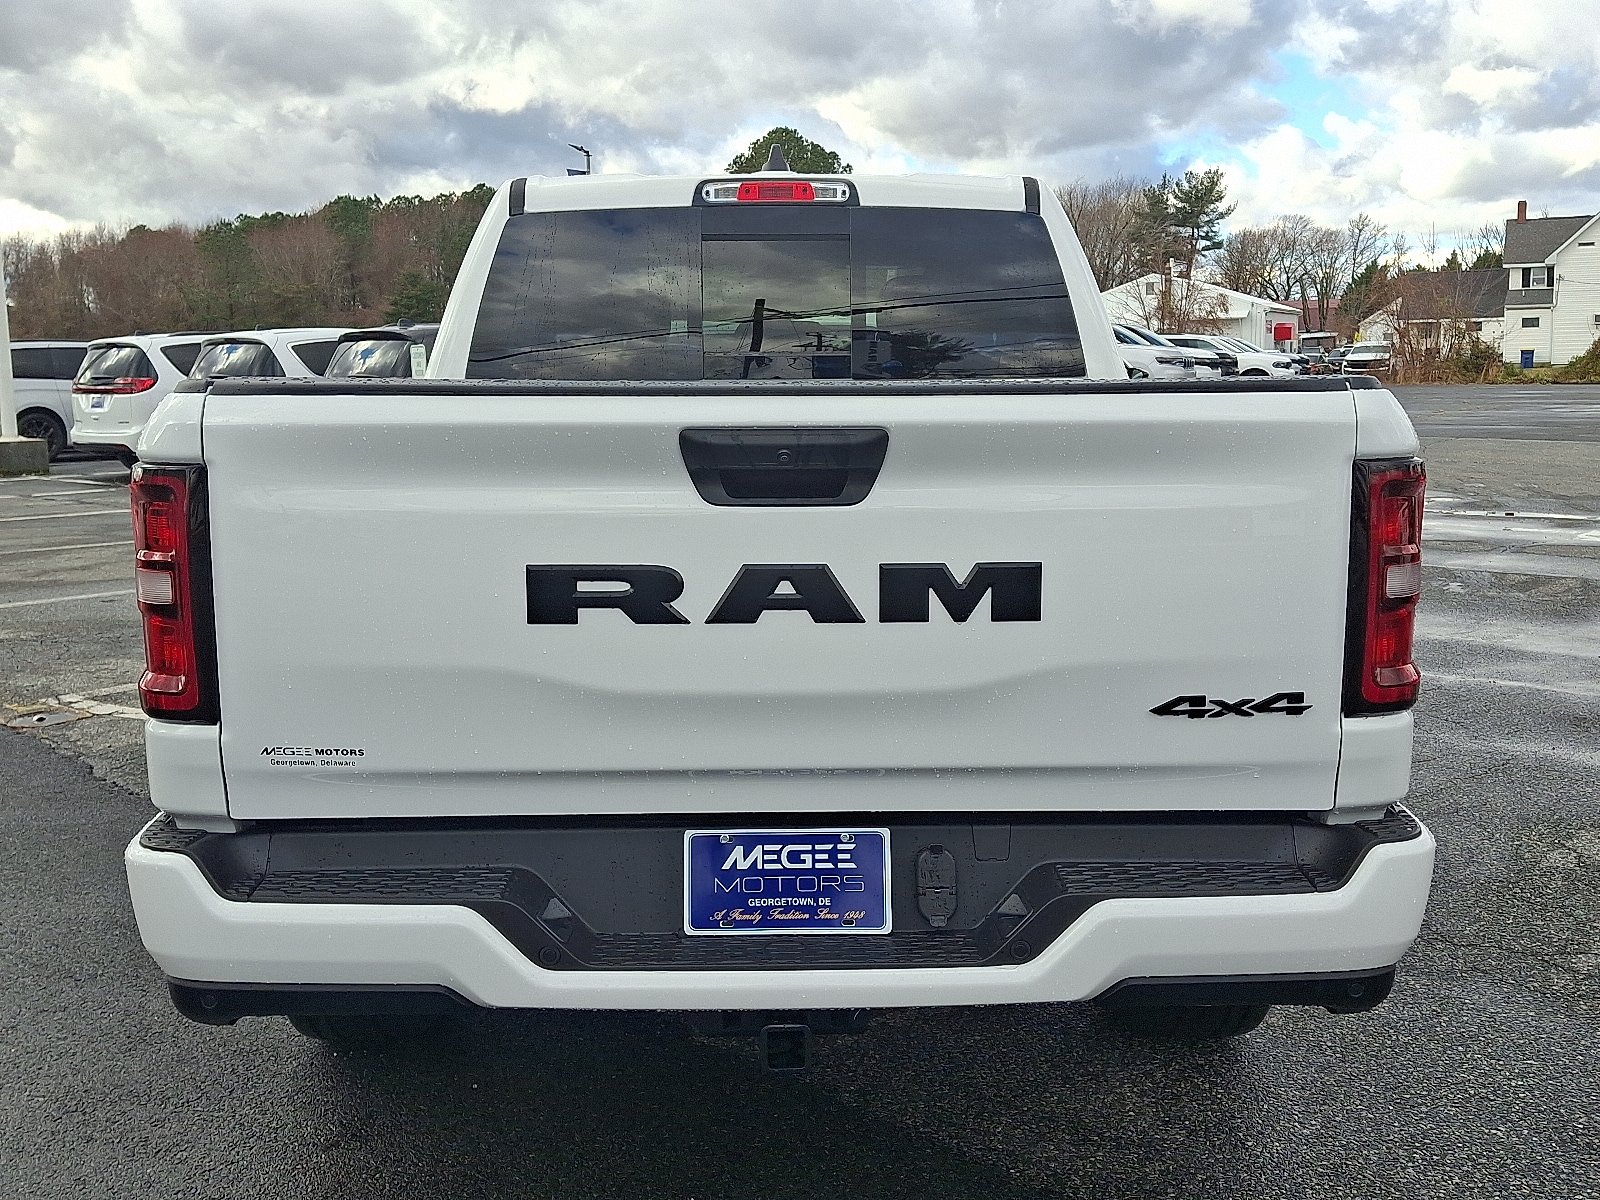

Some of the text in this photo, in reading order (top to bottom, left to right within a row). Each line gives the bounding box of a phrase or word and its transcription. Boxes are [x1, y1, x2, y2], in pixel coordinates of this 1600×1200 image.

[526, 562, 1042, 625] RAM
[1149, 691, 1313, 719] 4x4
[260, 747, 365, 757] MEGEE MOTORS
[270, 758, 318, 767] Georgetown,
[721, 843, 857, 870] MEGEE
[714, 875, 865, 894] MOTORS
[748, 897, 832, 907] GEORGETOWN, DE
[709, 908, 727, 921] A
[727, 908, 763, 924] Family
[767, 907, 810, 920] Tradition
[814, 907, 840, 920] Since
